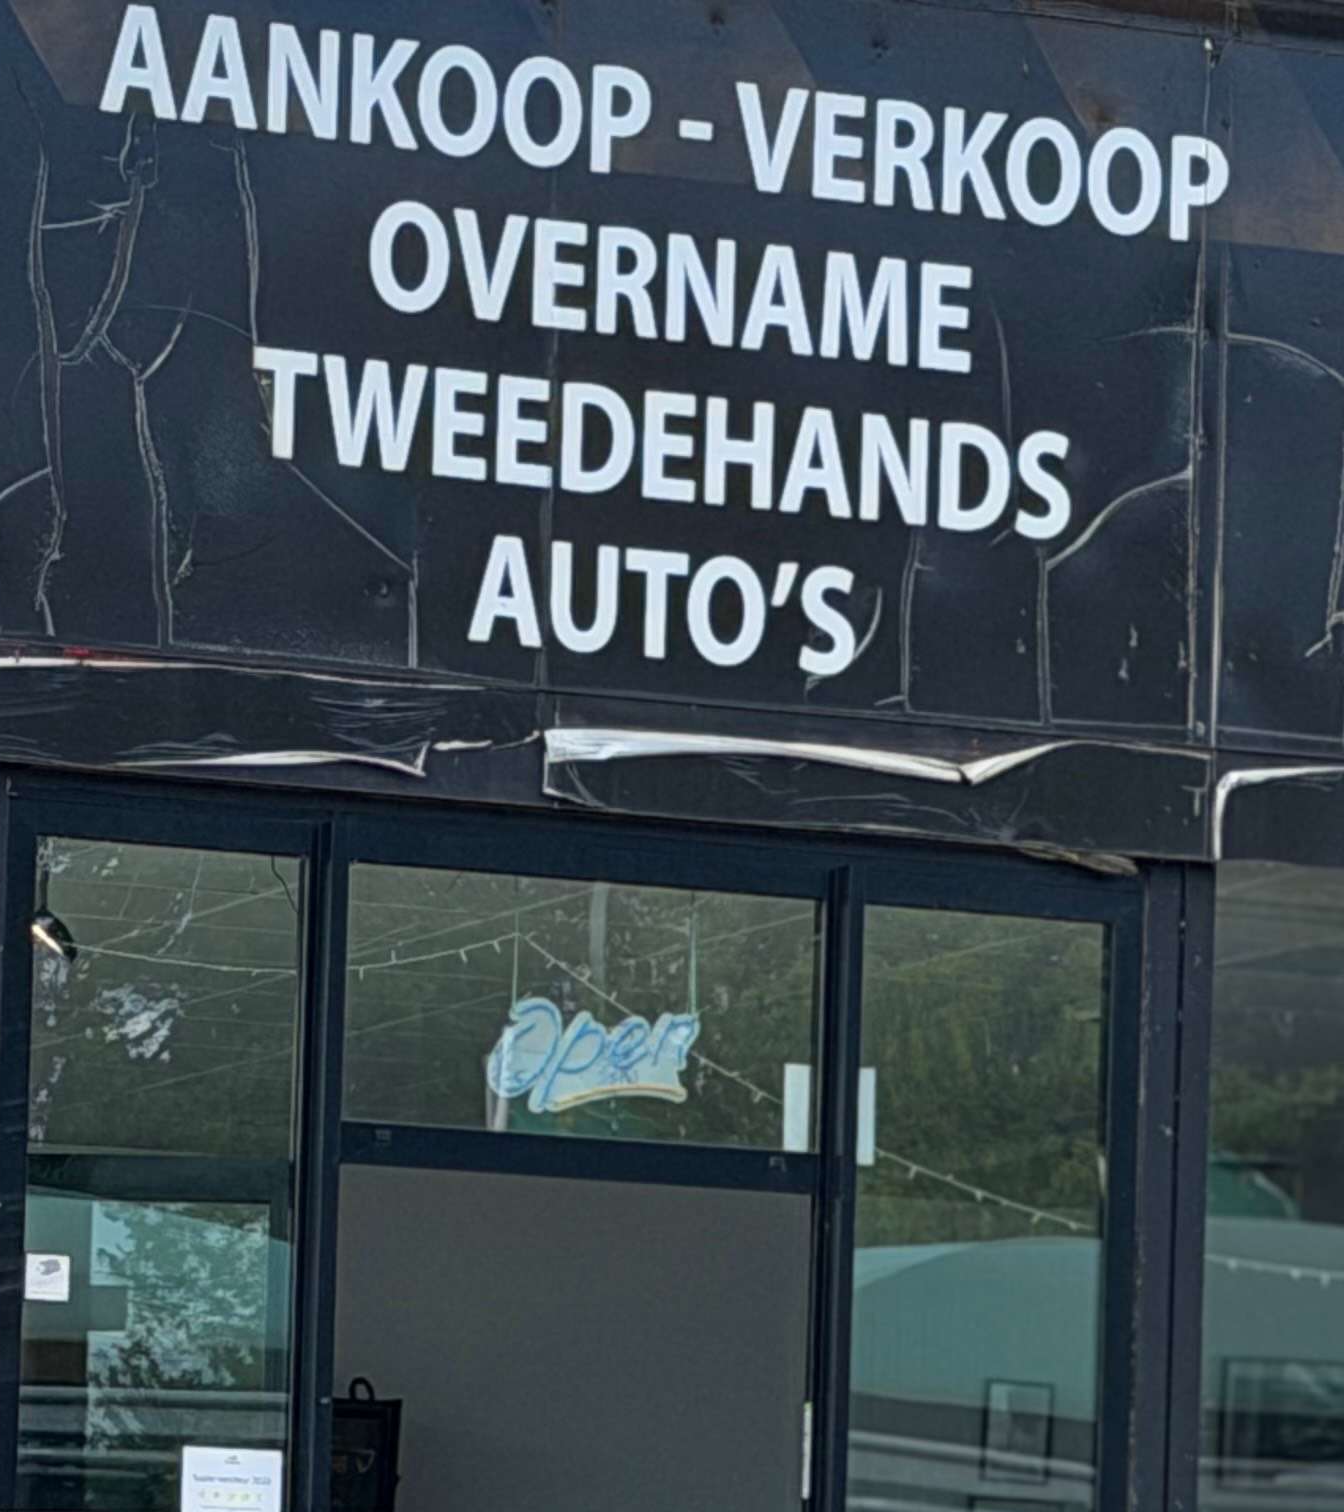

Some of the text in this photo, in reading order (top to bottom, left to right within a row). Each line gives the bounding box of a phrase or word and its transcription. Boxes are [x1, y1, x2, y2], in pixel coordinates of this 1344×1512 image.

[100, 4, 652, 174] AANKOOP
[736, 81, 1230, 242] VERKOOP
[369, 201, 973, 374] OVERNAME
[255, 347, 1072, 540] TWEEDEHANDS
[467, 535, 856, 677] AUTO'S
[490, 999, 698, 1111] Open
